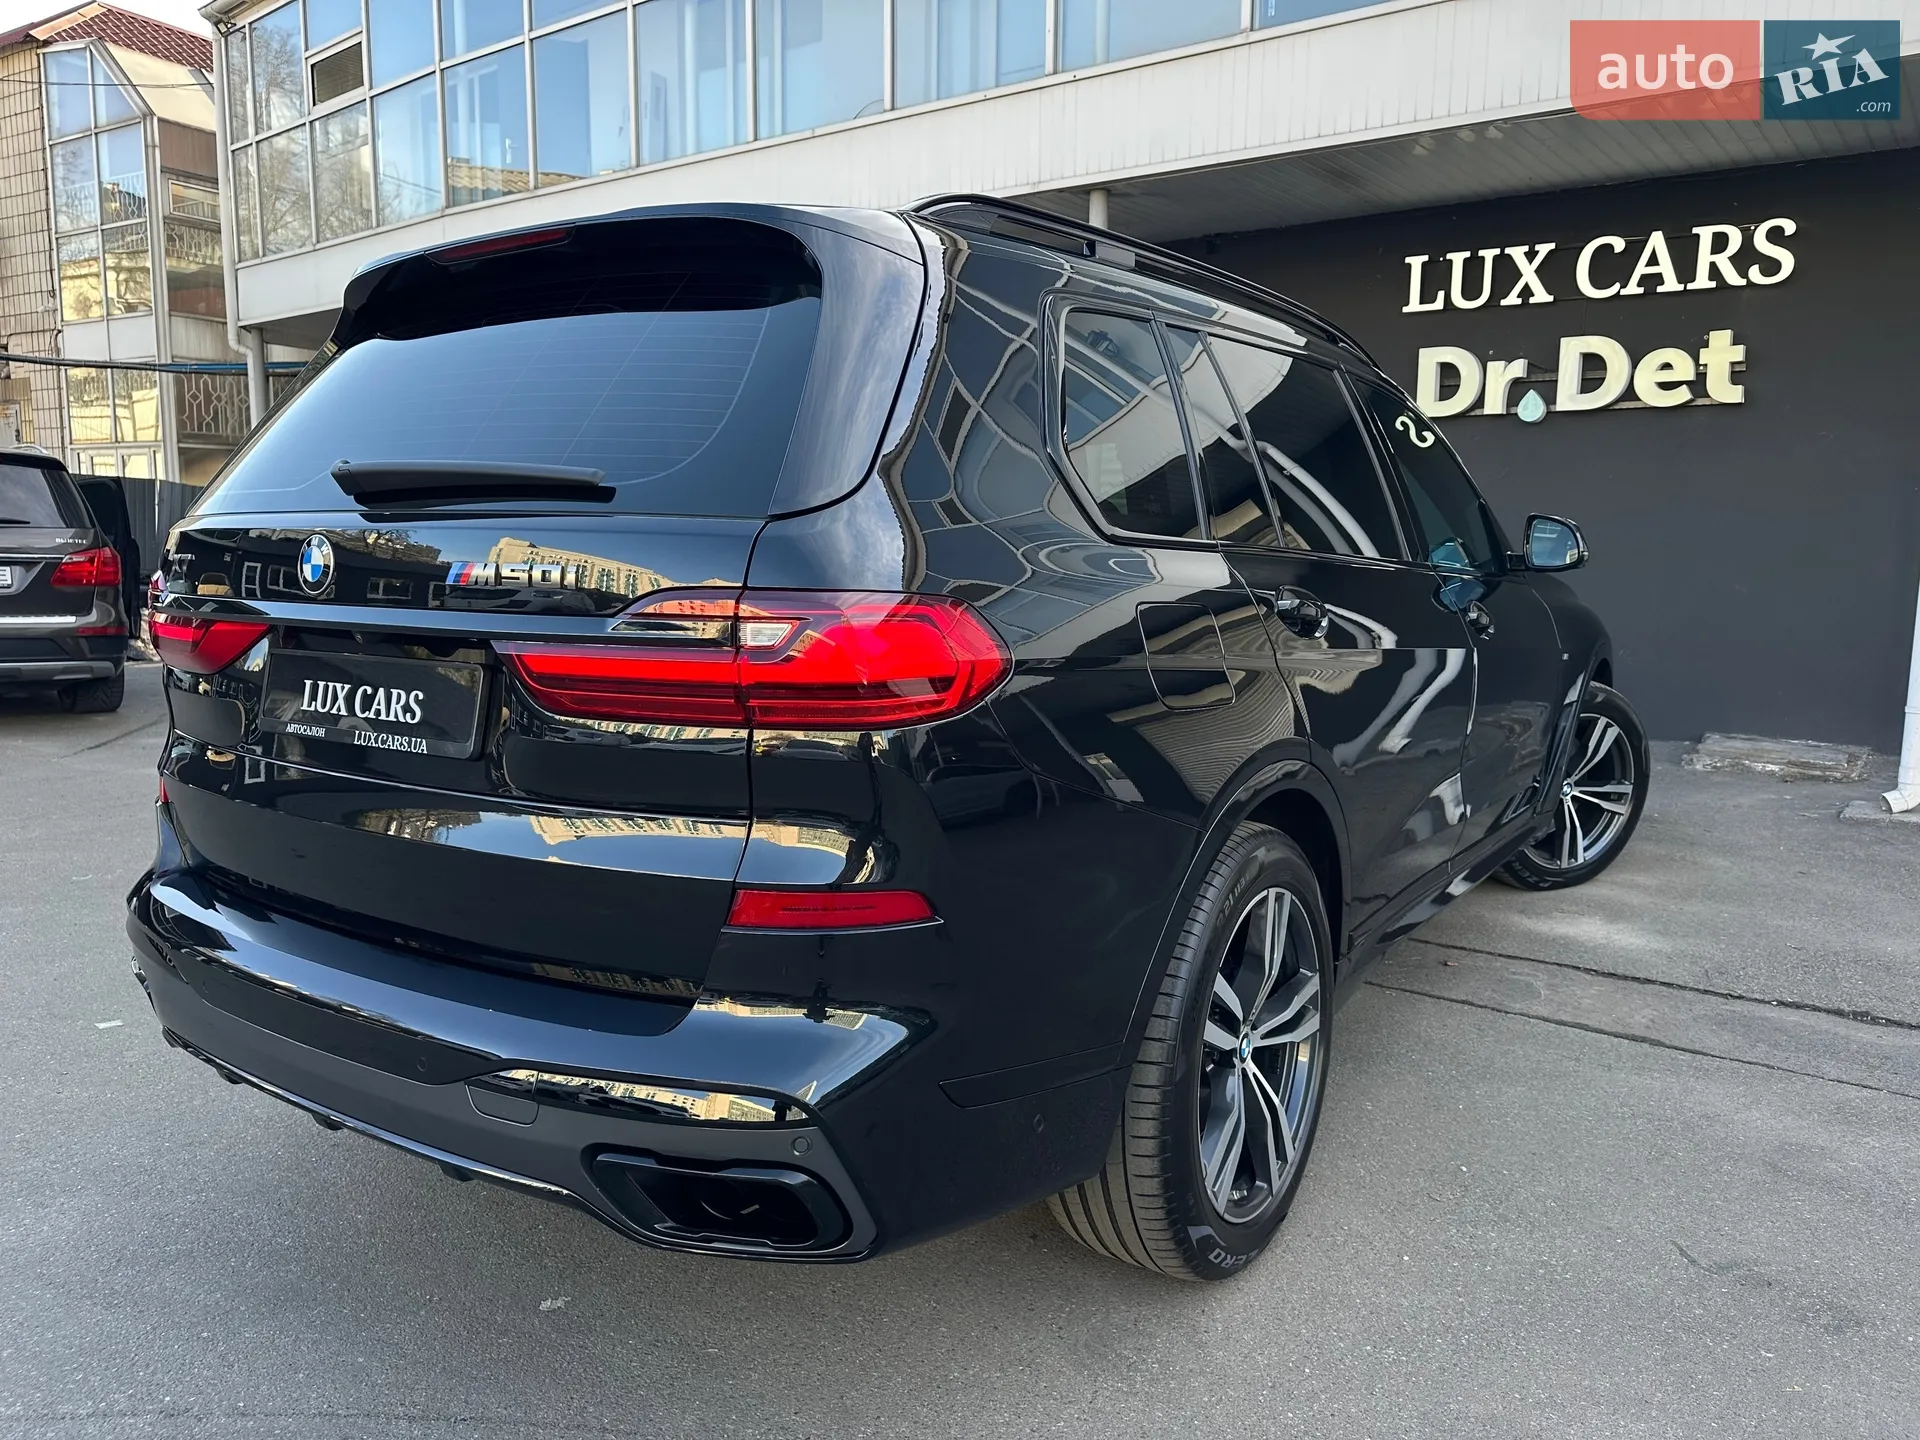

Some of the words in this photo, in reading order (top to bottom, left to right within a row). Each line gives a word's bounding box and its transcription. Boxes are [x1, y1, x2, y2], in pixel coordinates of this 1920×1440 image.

[1401, 242, 1555, 313] LUX
[1575, 217, 1797, 300] CARS
[300, 679, 351, 716] LUX
[354, 685, 424, 724] CARS
[286, 723, 325, 737] АВТОСАЛОН
[353, 730, 428, 754] LUX.CARS.UA
